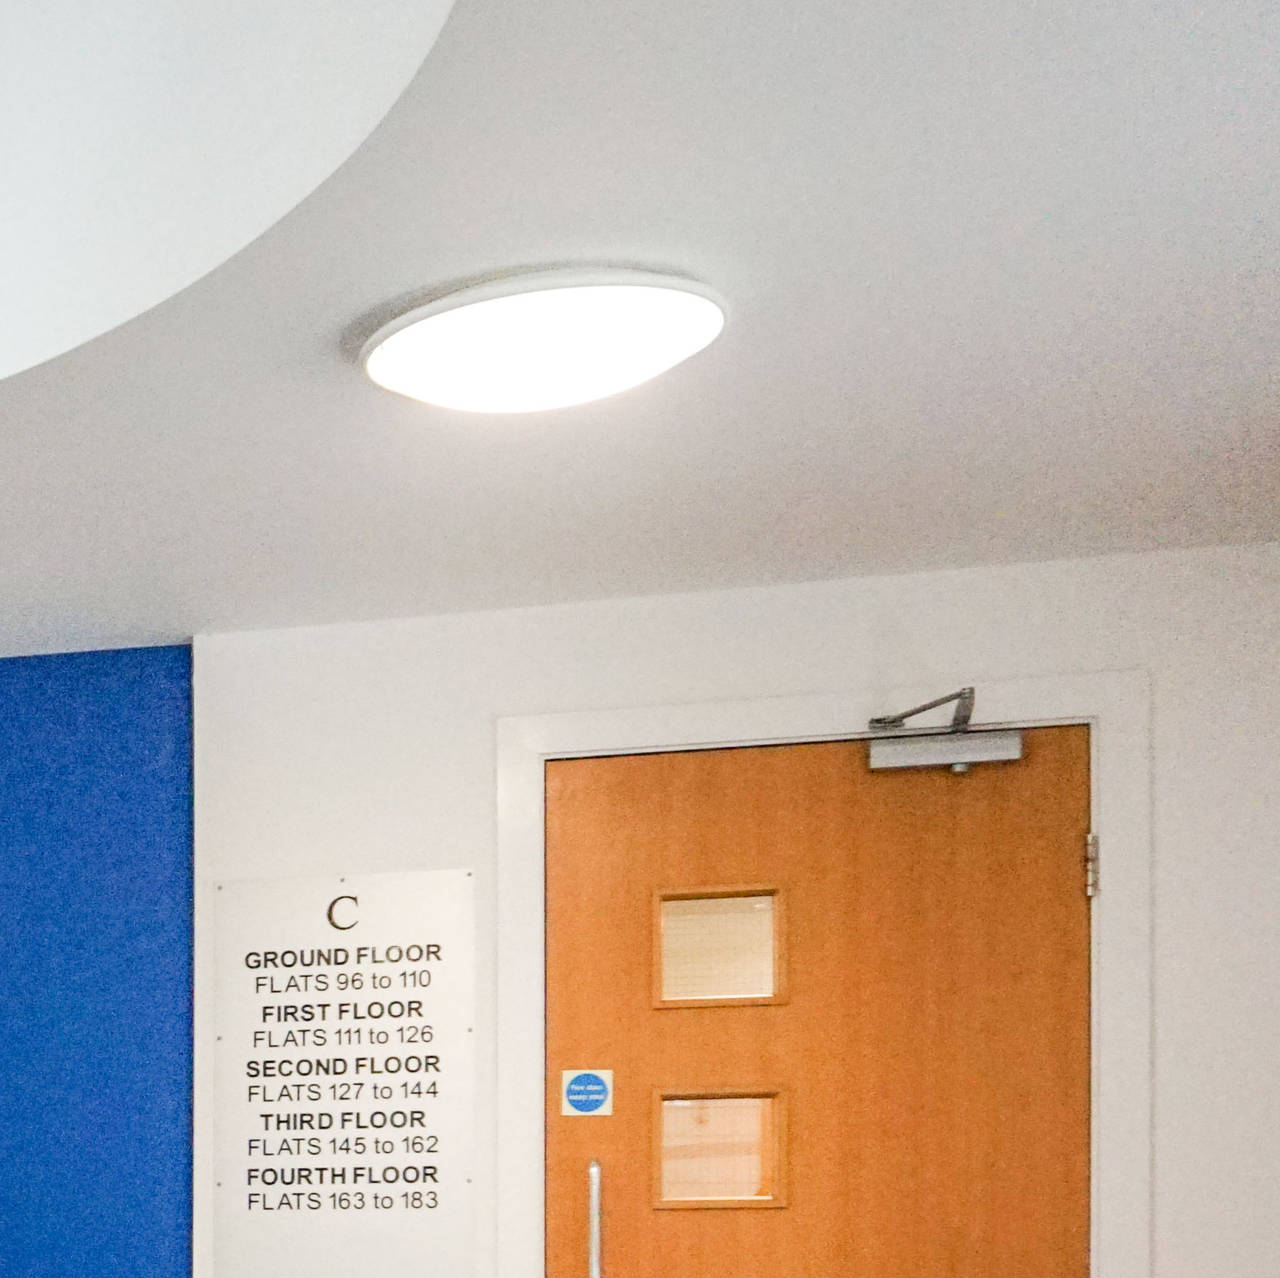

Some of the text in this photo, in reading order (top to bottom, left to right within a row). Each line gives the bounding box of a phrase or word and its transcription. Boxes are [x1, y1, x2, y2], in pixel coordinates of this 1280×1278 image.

[325, 895, 359, 931] C
[244, 943, 443, 970] GROUND FLOOR
[255, 969, 432, 994] FLATS 96 to 110
[261, 999, 424, 1024] FIRST FLOOR
[253, 1024, 434, 1049] FLATS 111 to 126
[245, 1054, 442, 1079] SECOND FLOOR
[247, 1080, 439, 1103] FLATS 127 to 144
[259, 1110, 427, 1132] THIRD FLOOR
[247, 1135, 439, 1157] FLATS 145 to 162
[246, 1165, 440, 1187] FOURTH FLOOR
[247, 1190, 439, 1211] FLATS 163 to 183
